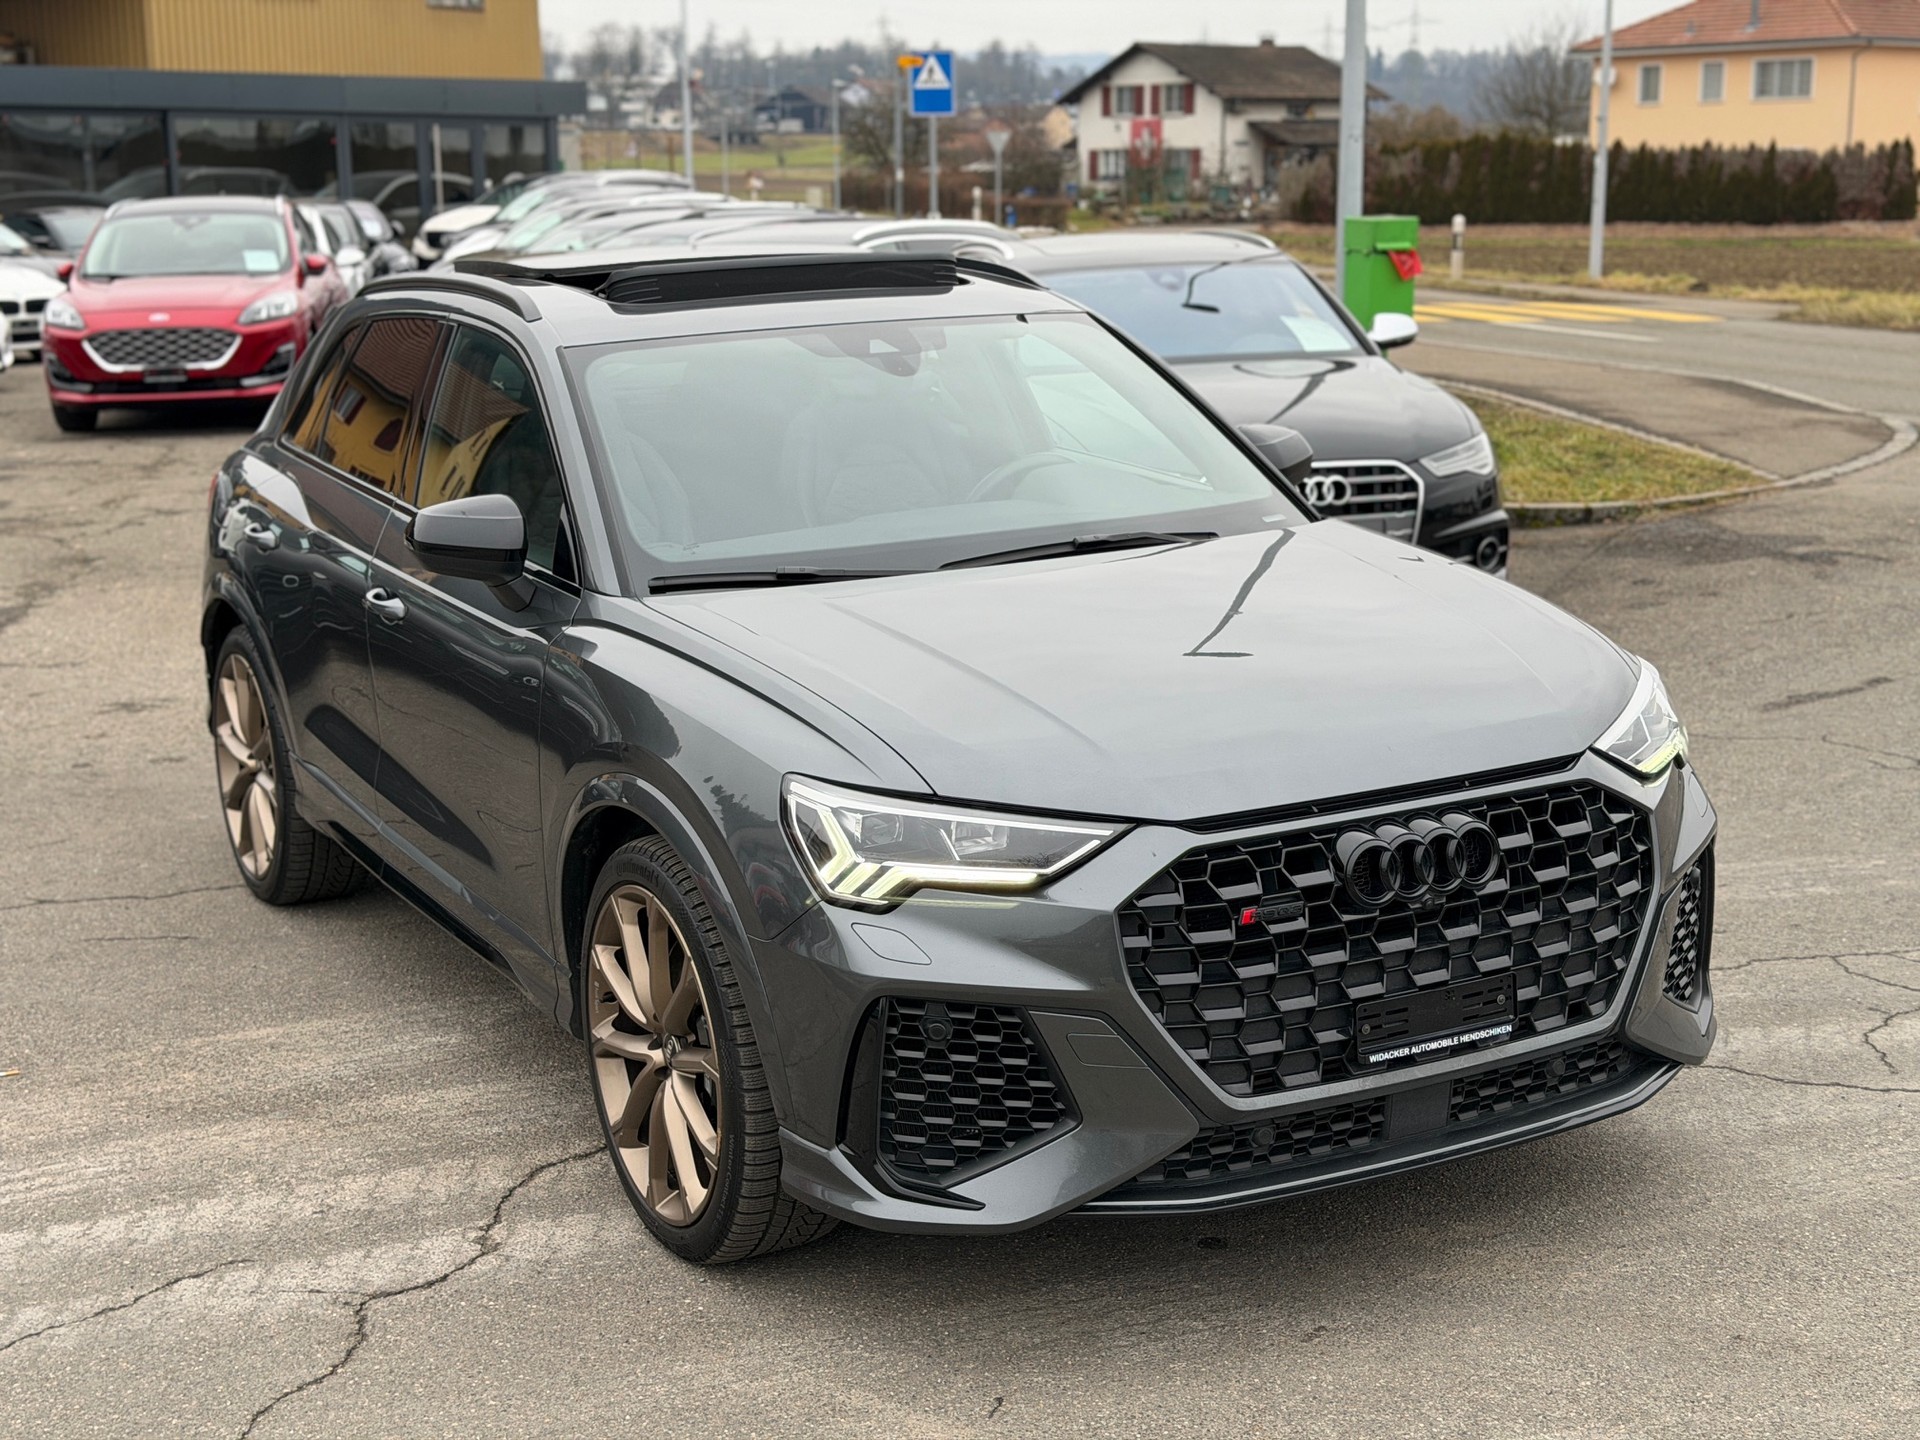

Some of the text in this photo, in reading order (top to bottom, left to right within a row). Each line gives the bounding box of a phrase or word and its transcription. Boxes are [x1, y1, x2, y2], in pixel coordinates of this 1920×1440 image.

[1369, 1024, 1513, 1063] WIDACKER AUTOMOBILE HENDSCHIKEN
